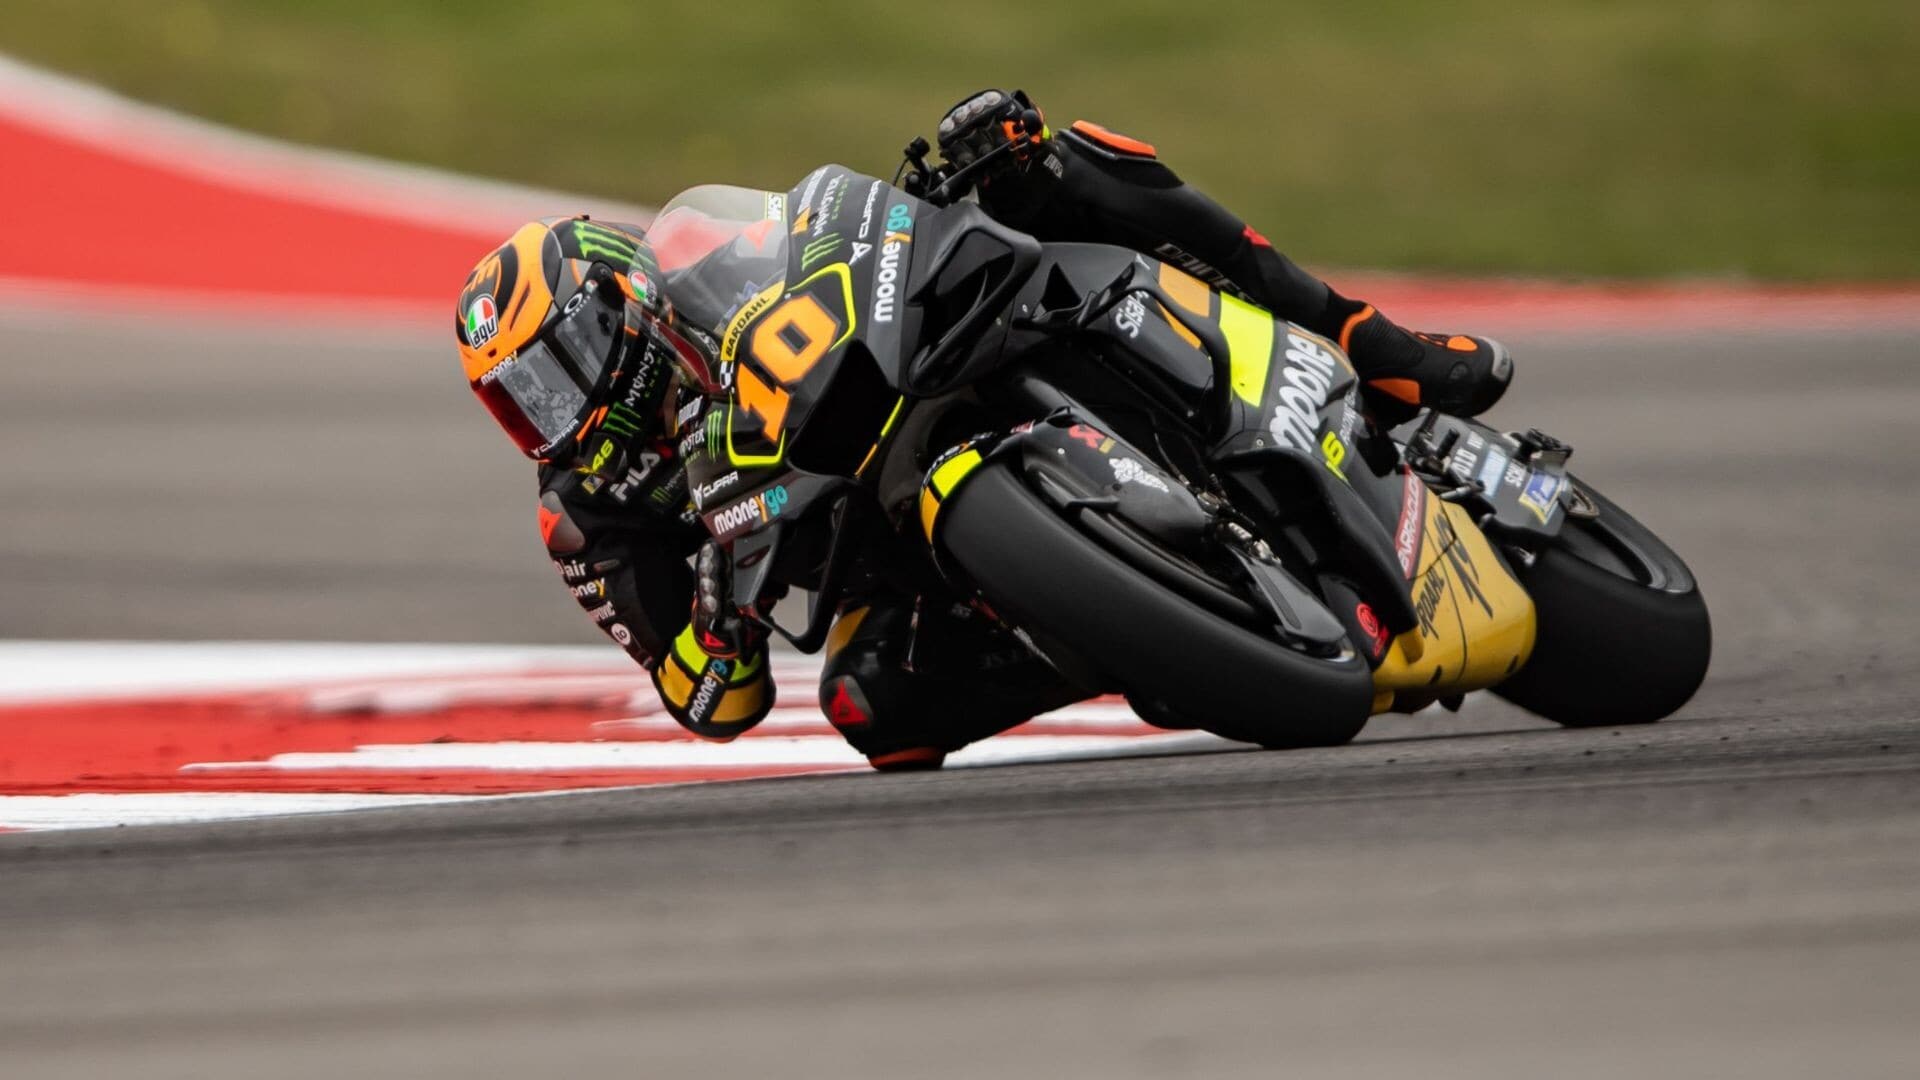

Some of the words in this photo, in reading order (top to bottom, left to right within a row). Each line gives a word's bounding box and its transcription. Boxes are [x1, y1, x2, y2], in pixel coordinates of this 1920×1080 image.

[859, 180, 882, 239] CUPRA
[874, 203, 913, 323] mooneygo
[472, 321, 496, 344] agv
[725, 297, 769, 357] BARDAHL
[481, 351, 519, 385] mooney
[625, 342, 660, 407] MONST
[736, 292, 840, 444] 10
[1270, 332, 1336, 454] moone
[539, 419, 579, 453] CUPRA
[592, 438, 614, 471] 46
[609, 452, 660, 503] FILA
[702, 471, 739, 496] CUPRA
[714, 485, 787, 535] mooneygo
[572, 577, 606, 598] oney
